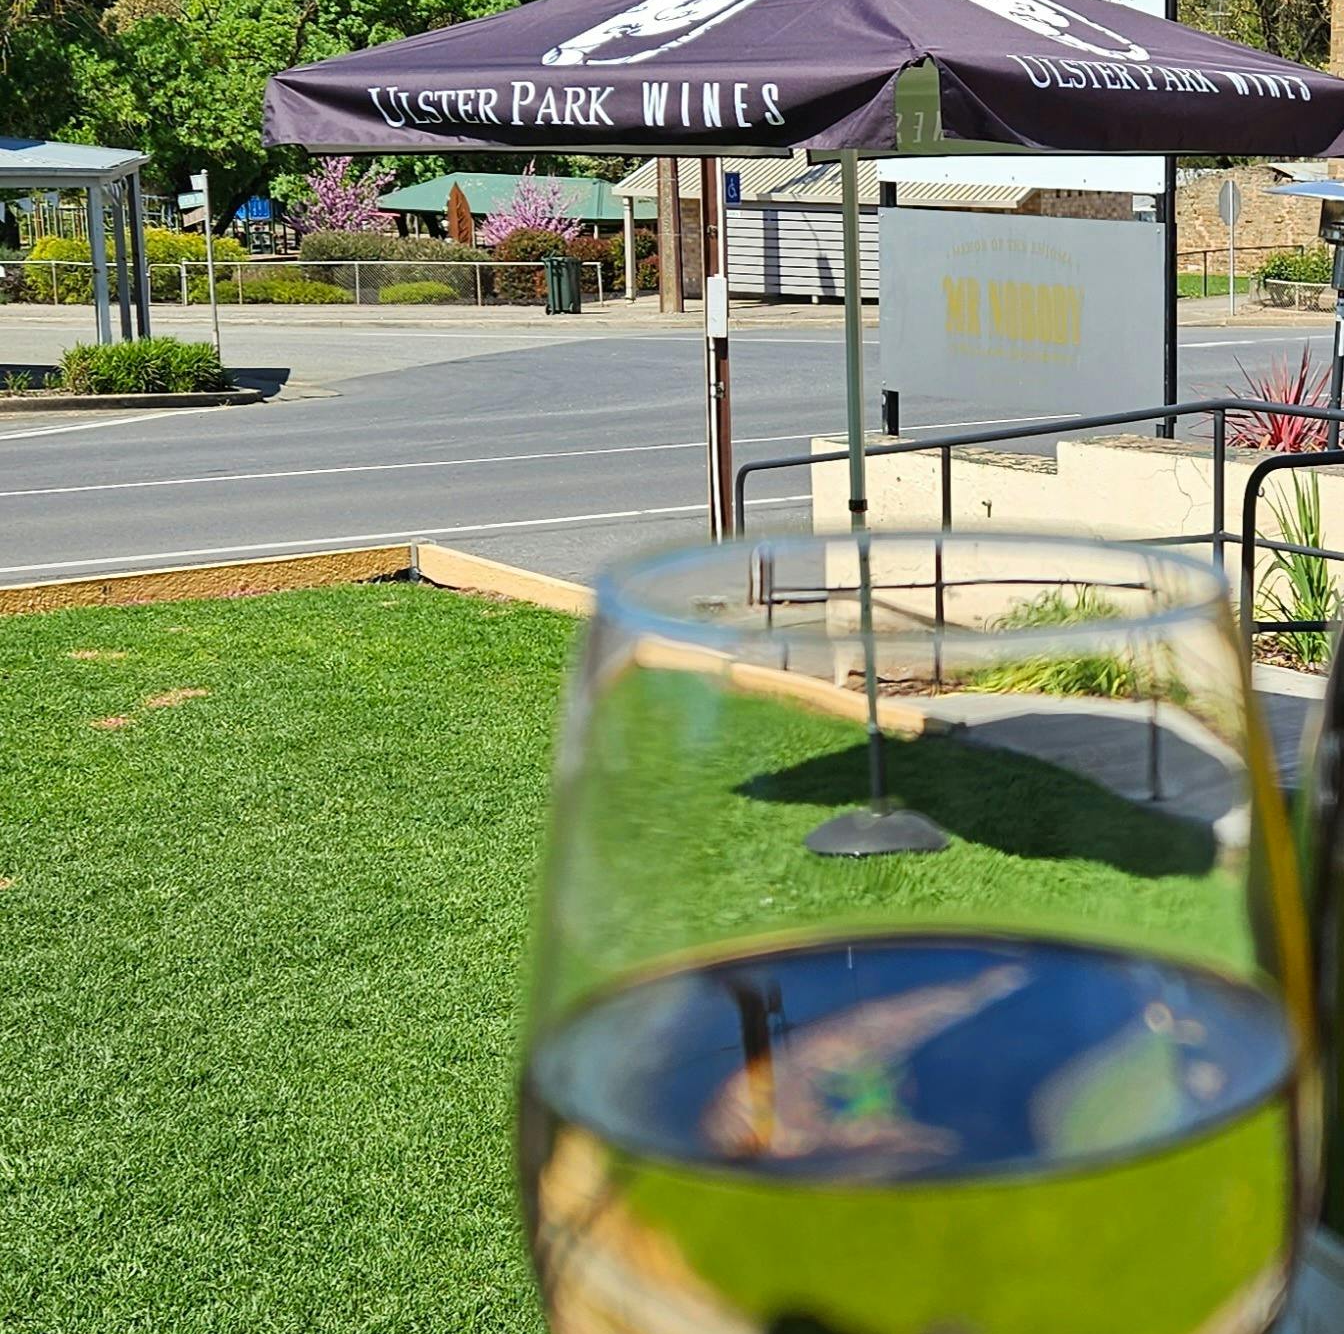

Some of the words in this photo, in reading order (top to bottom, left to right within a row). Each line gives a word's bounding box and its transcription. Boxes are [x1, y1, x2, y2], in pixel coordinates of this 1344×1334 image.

[1006, 54, 1140, 91] ULSTER
[1126, 63, 1220, 94] PARK
[368, 85, 502, 128] ULSTER
[510, 80, 615, 127] PARK
[641, 81, 785, 128] WINES
[942, 275, 981, 335] MR
